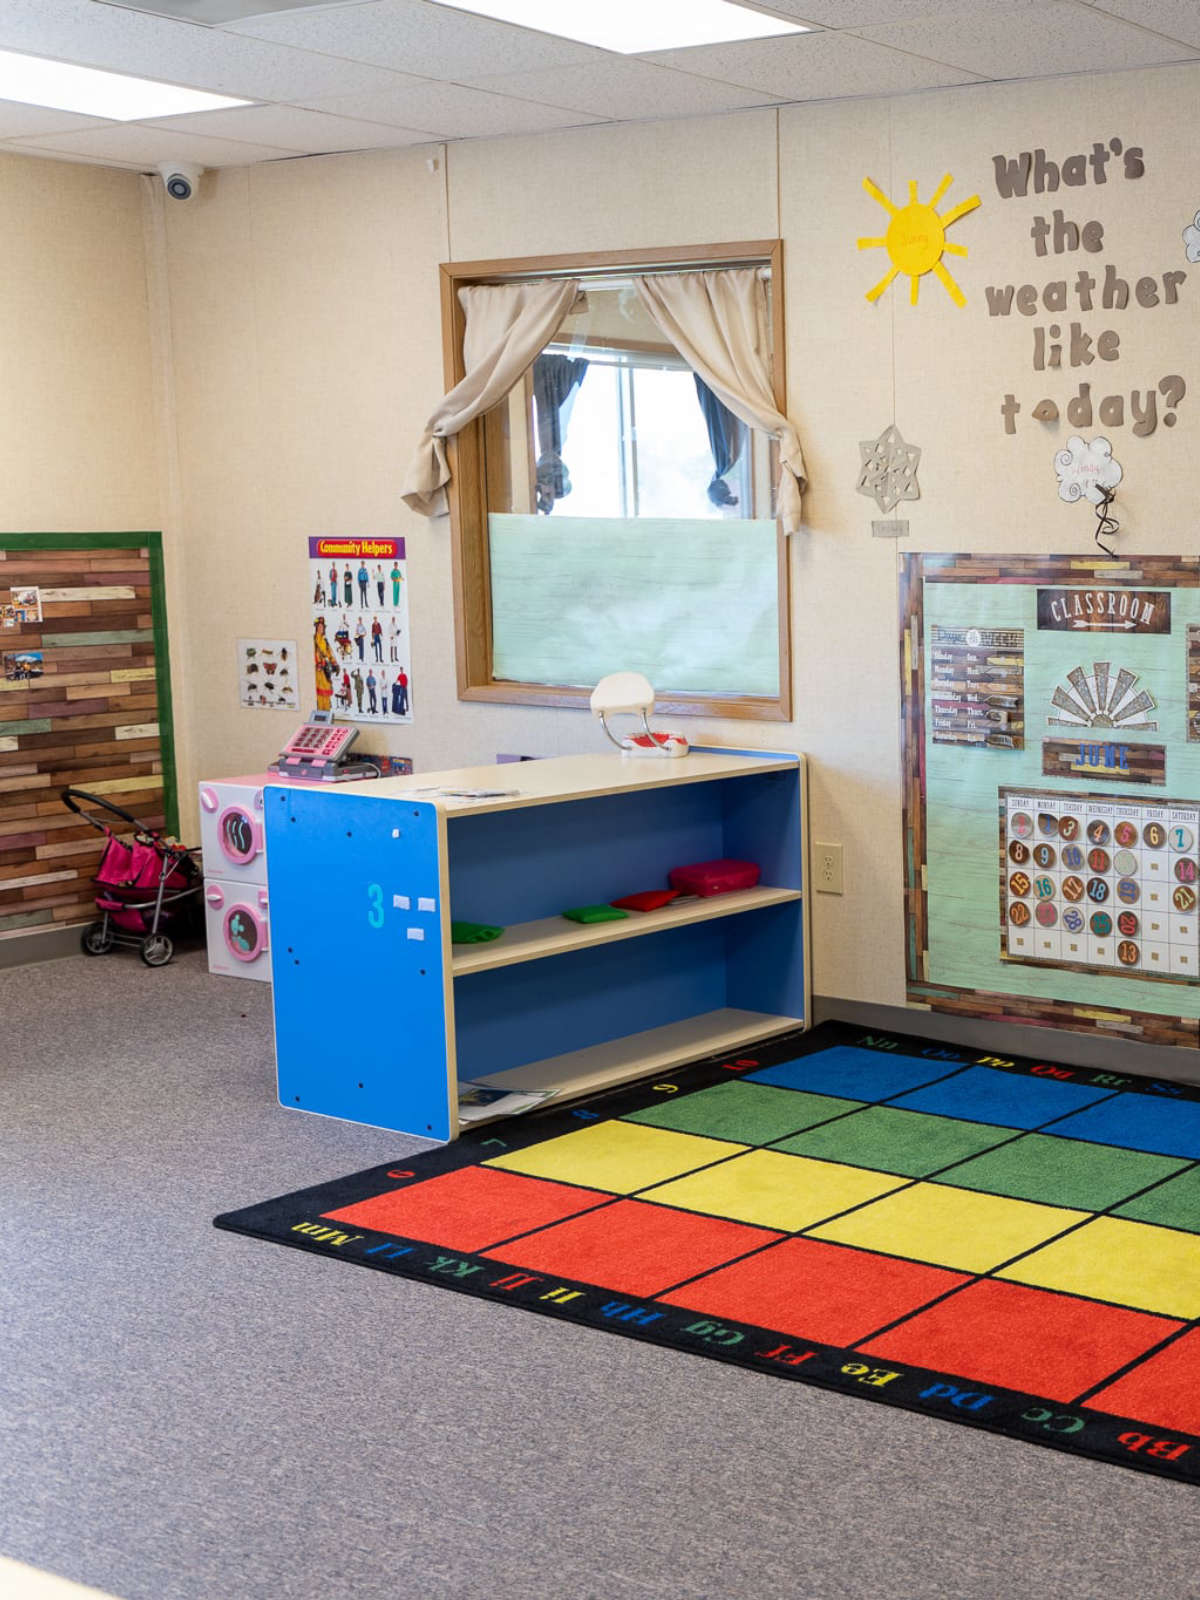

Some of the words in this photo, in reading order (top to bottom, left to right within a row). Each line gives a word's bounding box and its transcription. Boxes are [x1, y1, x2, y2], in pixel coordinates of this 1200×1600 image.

[992, 137, 1145, 198] What's
[1031, 210, 1104, 256] the
[985, 265, 1187, 316] weather
[1033, 322, 1120, 370] like
[1001, 375, 1187, 437] today?
[320, 540, 360, 556] Community
[361, 540, 393, 557] Helpers
[1051, 592, 1155, 625] CLASSROOM
[1075, 743, 1128, 770] JUNE
[1063, 820, 1076, 837] 3
[1093, 823, 1104, 842] 4
[1150, 826, 1159, 845] 6
[1175, 828, 1185, 848] 7
[1015, 844, 1023, 860] 8
[1041, 848, 1049, 864] 9
[1178, 861, 1195, 880] 14
[368, 883, 384, 928] 3
[1011, 874, 1029, 895] 15
[1036, 879, 1053, 897] 16
[1089, 879, 1107, 900] 18
[1175, 889, 1194, 909] 21
[1011, 905, 1028, 924] 22
[1122, 943, 1138, 962] 13
